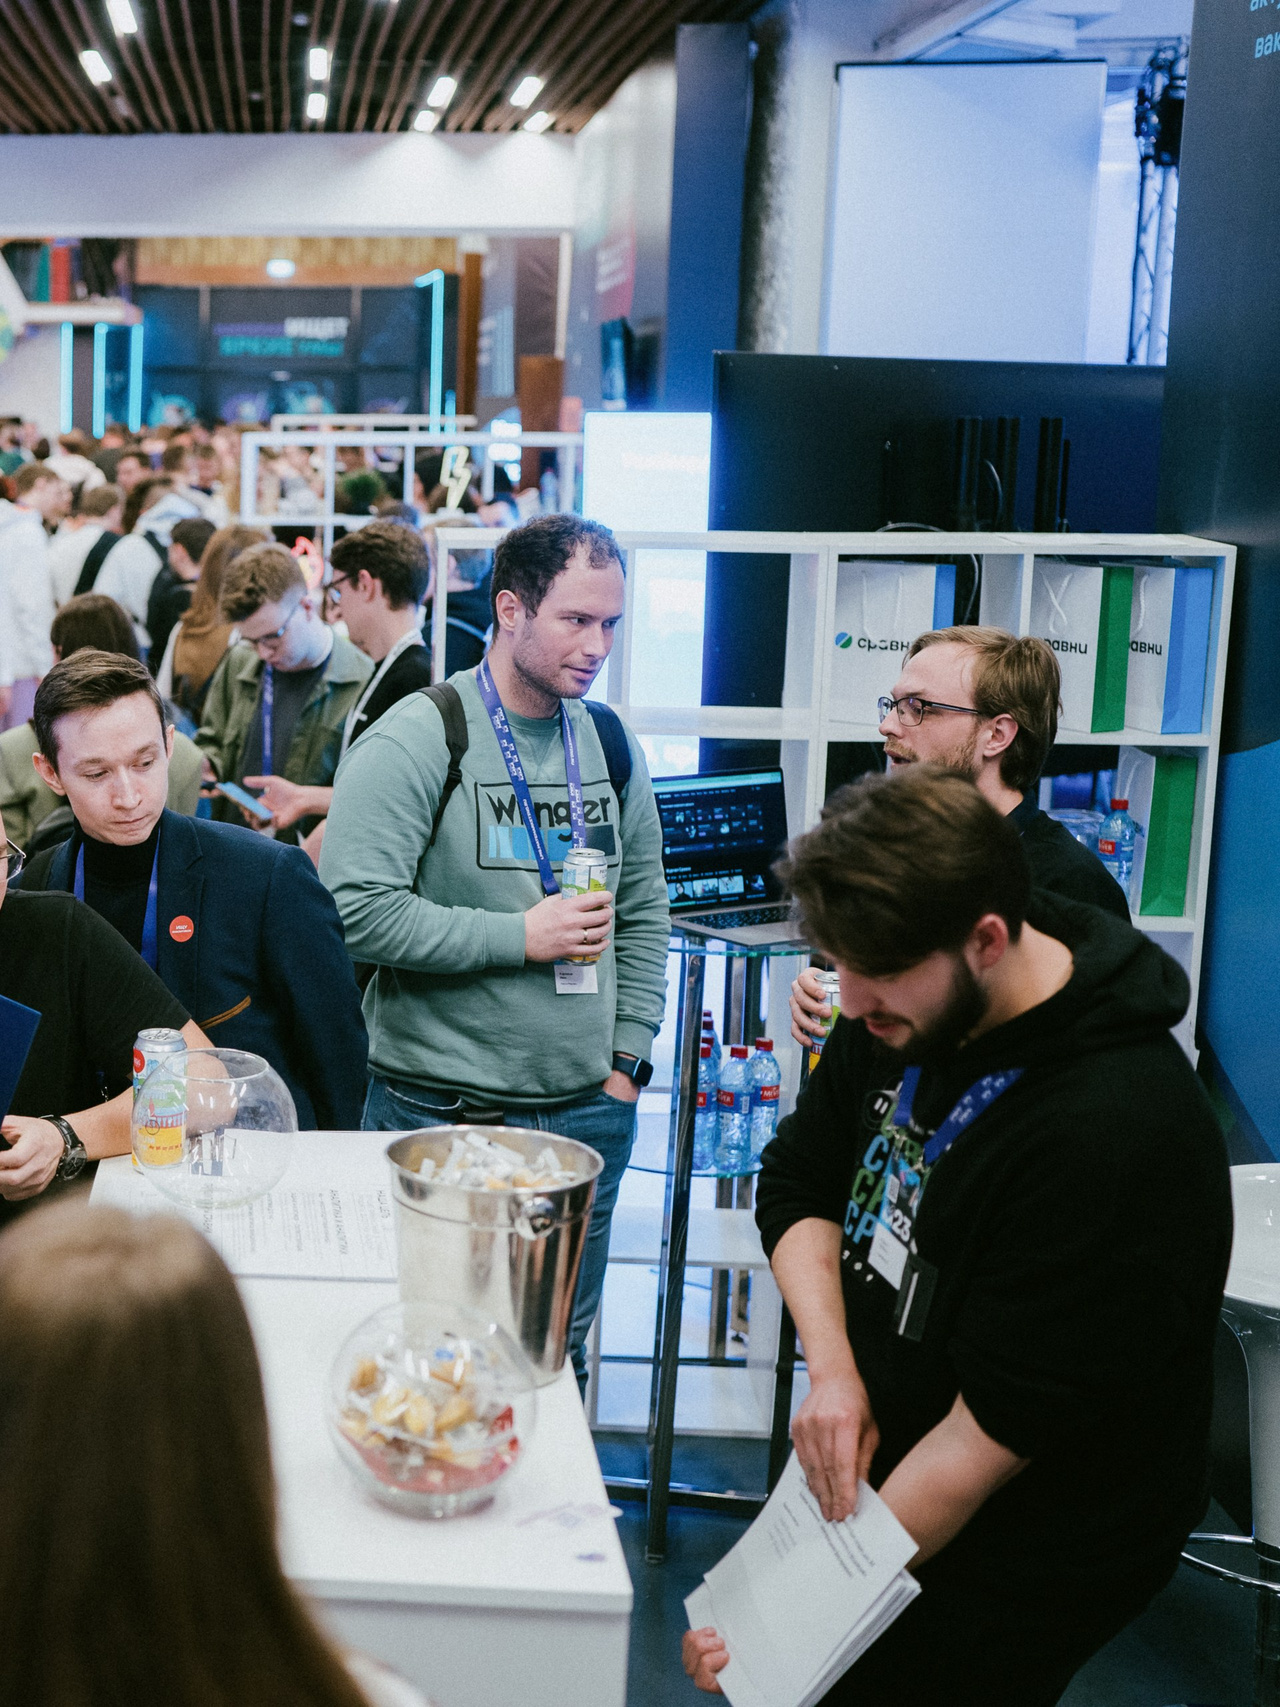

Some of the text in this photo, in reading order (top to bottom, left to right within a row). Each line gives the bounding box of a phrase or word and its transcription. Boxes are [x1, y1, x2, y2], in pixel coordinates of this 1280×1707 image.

[857, 638, 909, 652] сравн
[1128, 640, 1163, 656] авни
[485, 791, 611, 843] Wnger
